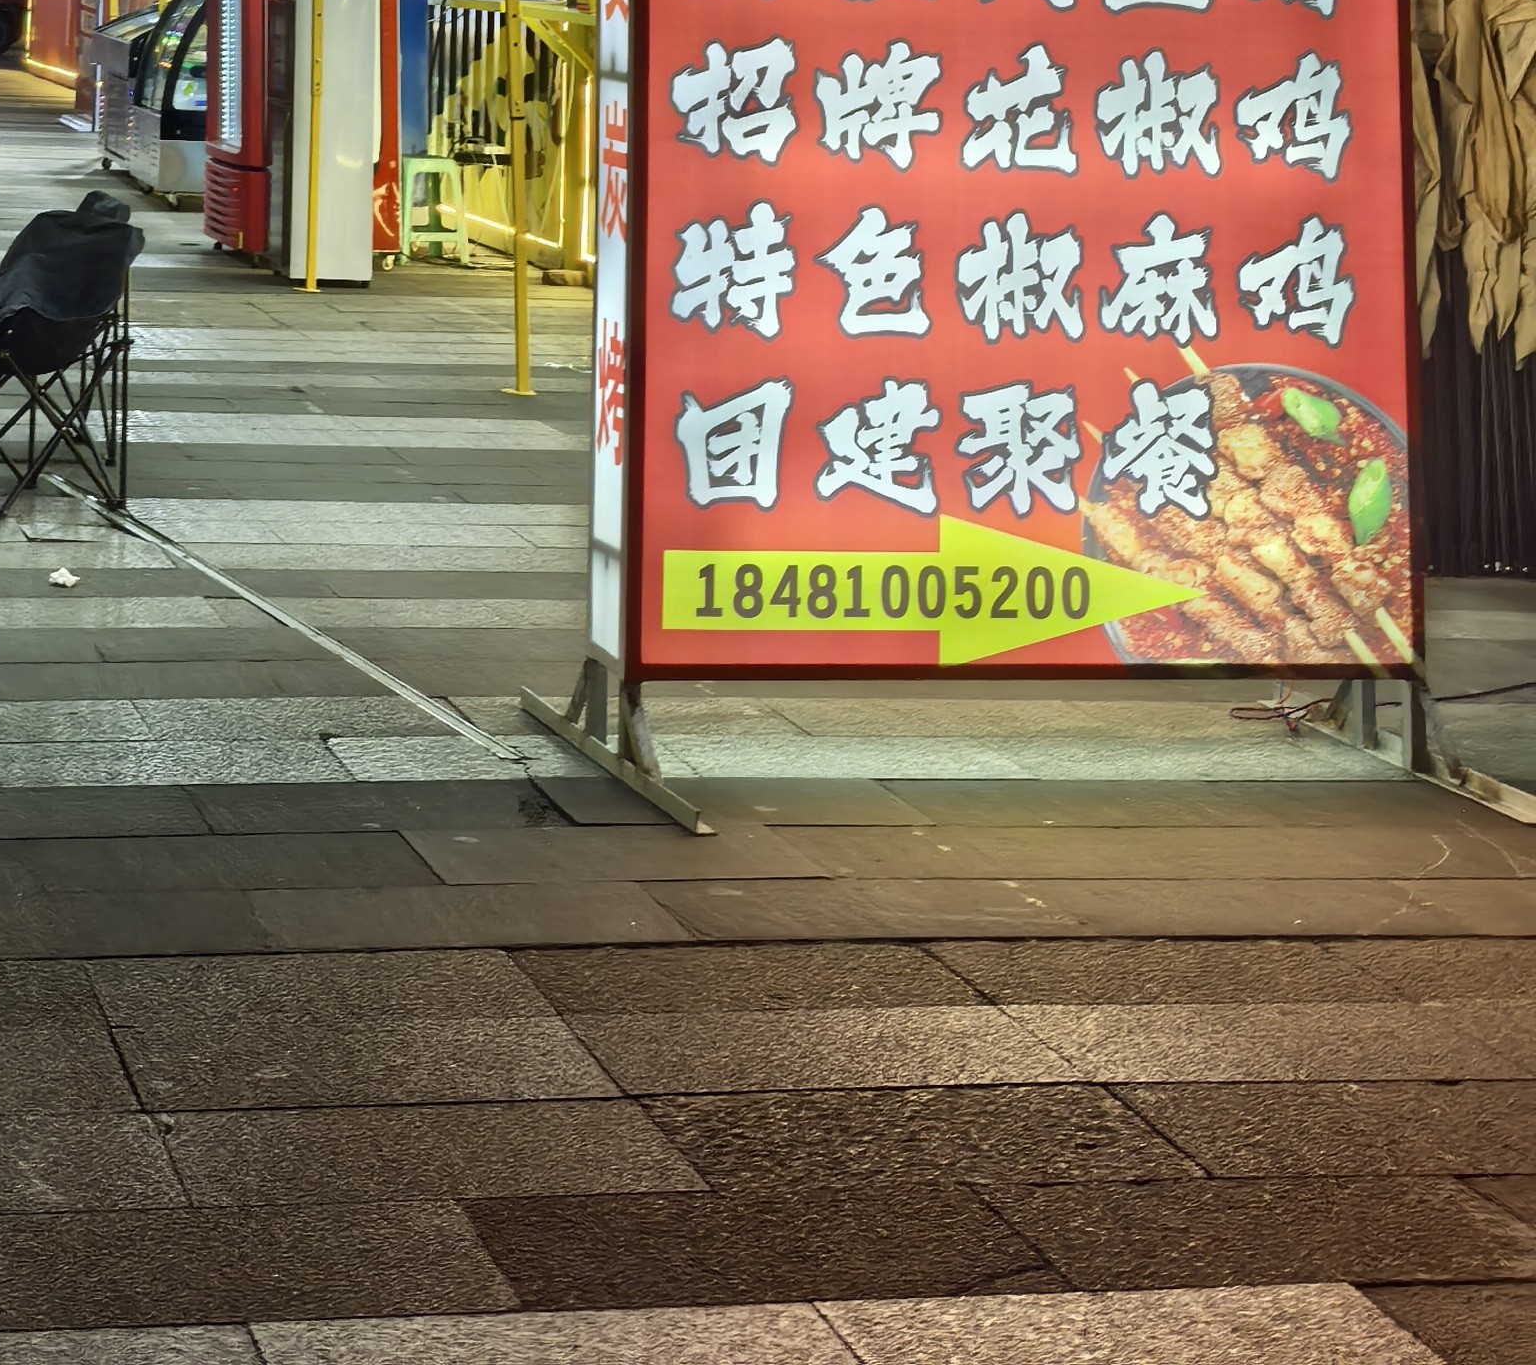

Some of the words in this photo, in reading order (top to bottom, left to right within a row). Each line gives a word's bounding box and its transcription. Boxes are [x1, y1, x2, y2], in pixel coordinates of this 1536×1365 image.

[670, 35, 1350, 182] 招牌花椒鸡
[670, 199, 1355, 348] 特色椒麻鸡
[675, 376, 1218, 520] 团建聚餐
[695, 562, 1092, 621] 18481005200
